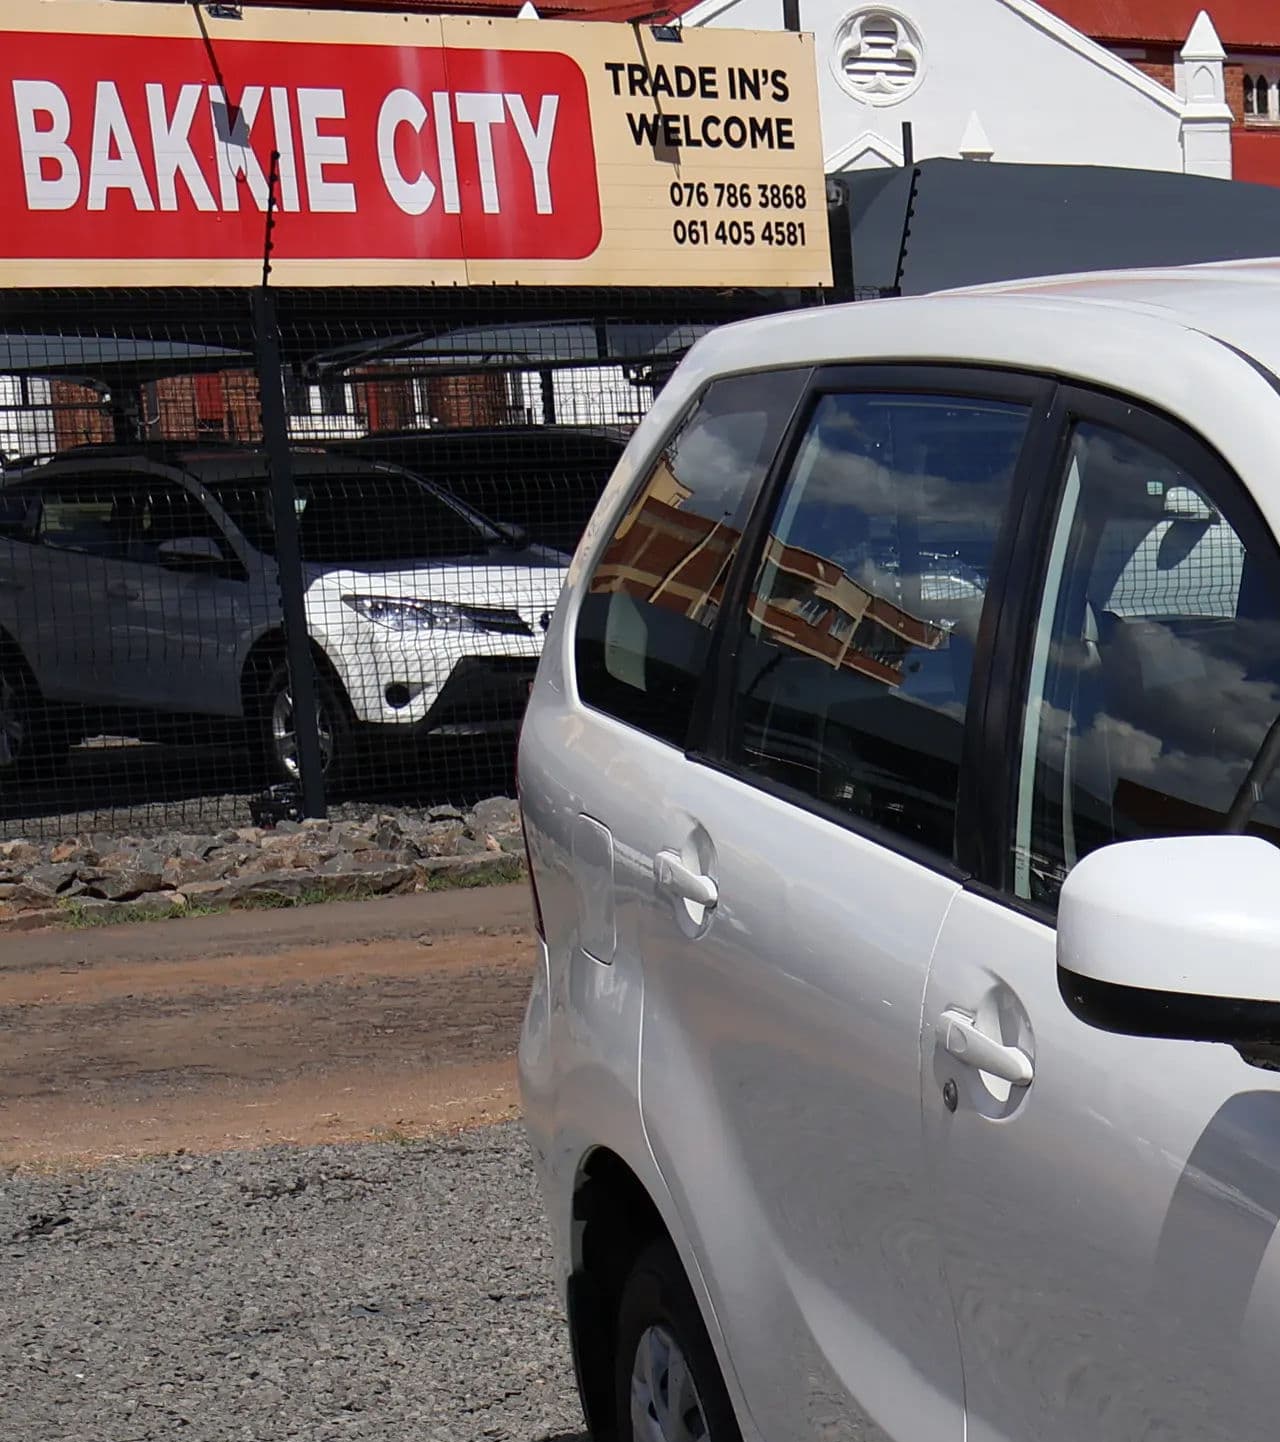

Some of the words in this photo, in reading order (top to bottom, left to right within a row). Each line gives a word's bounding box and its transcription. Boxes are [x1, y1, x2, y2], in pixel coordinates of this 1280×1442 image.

[604, 62, 719, 98] TRADE
[727, 67, 789, 102] IN'S
[12, 80, 357, 212] BAKKIE
[376, 88, 560, 215] CITY
[626, 112, 795, 150] WELCOME
[669, 182, 708, 207] 076
[713, 183, 752, 208] 786
[757, 184, 807, 209] 3868
[673, 219, 708, 245] 061
[715, 220, 755, 246] 405
[761, 221, 806, 247] 4581
